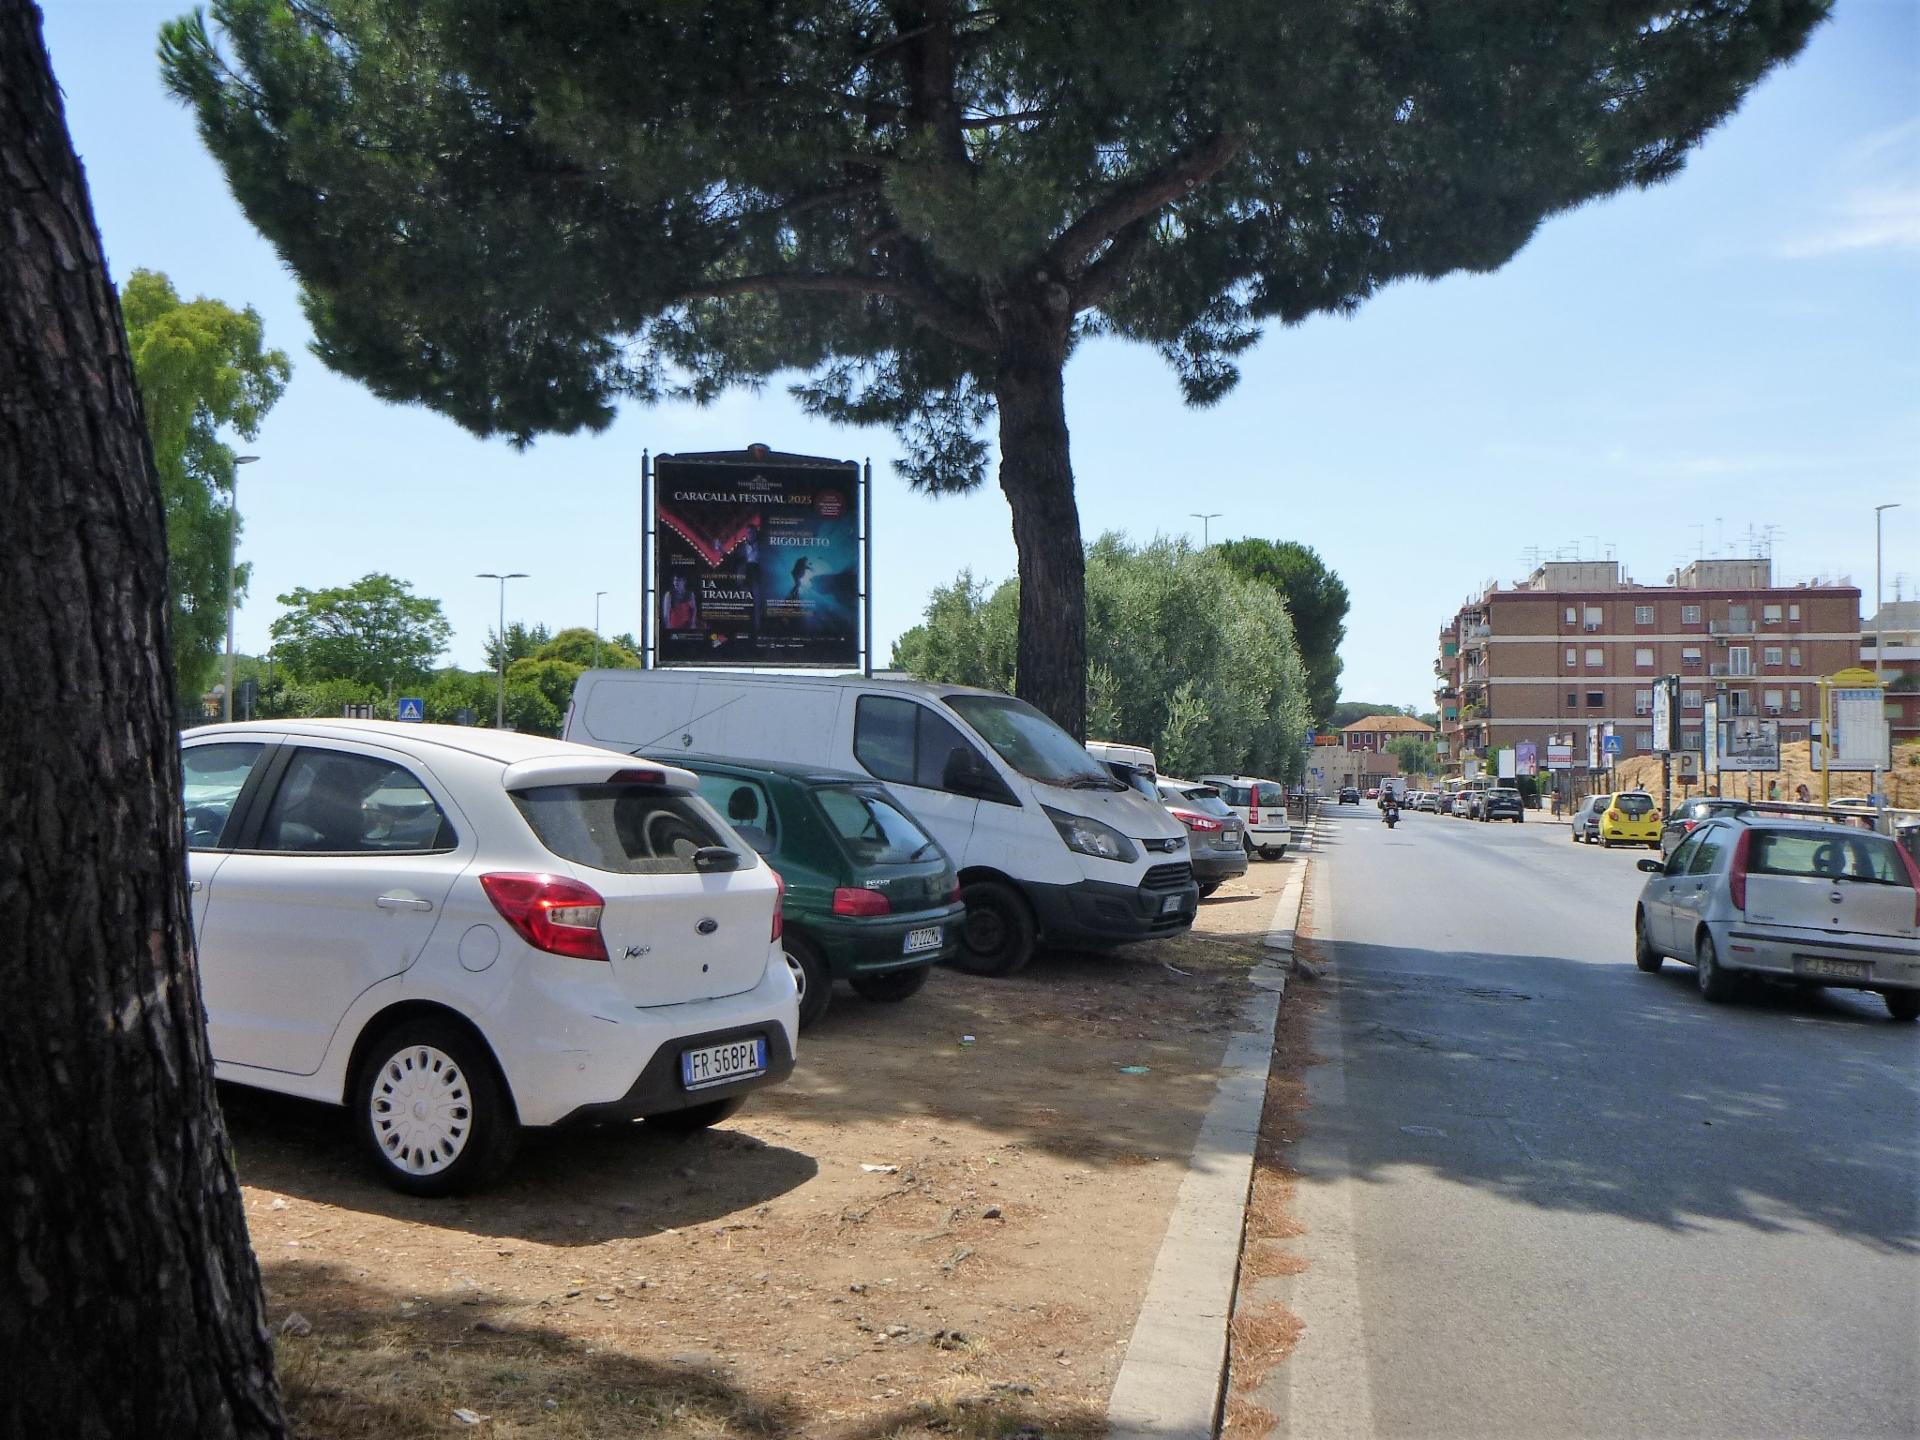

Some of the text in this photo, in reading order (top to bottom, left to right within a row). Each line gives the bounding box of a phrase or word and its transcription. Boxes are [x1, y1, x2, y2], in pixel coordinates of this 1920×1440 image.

[674, 491, 737, 503] CARACALLA
[739, 493, 786, 504] FESTIVAL
[769, 536, 830, 547] RIGOLETTO
[702, 580, 717, 589] LA
[702, 590, 754, 600] TRAVIATA
[1681, 755, 1692, 772] P
[692, 1044, 757, 1079] FR 568PA
